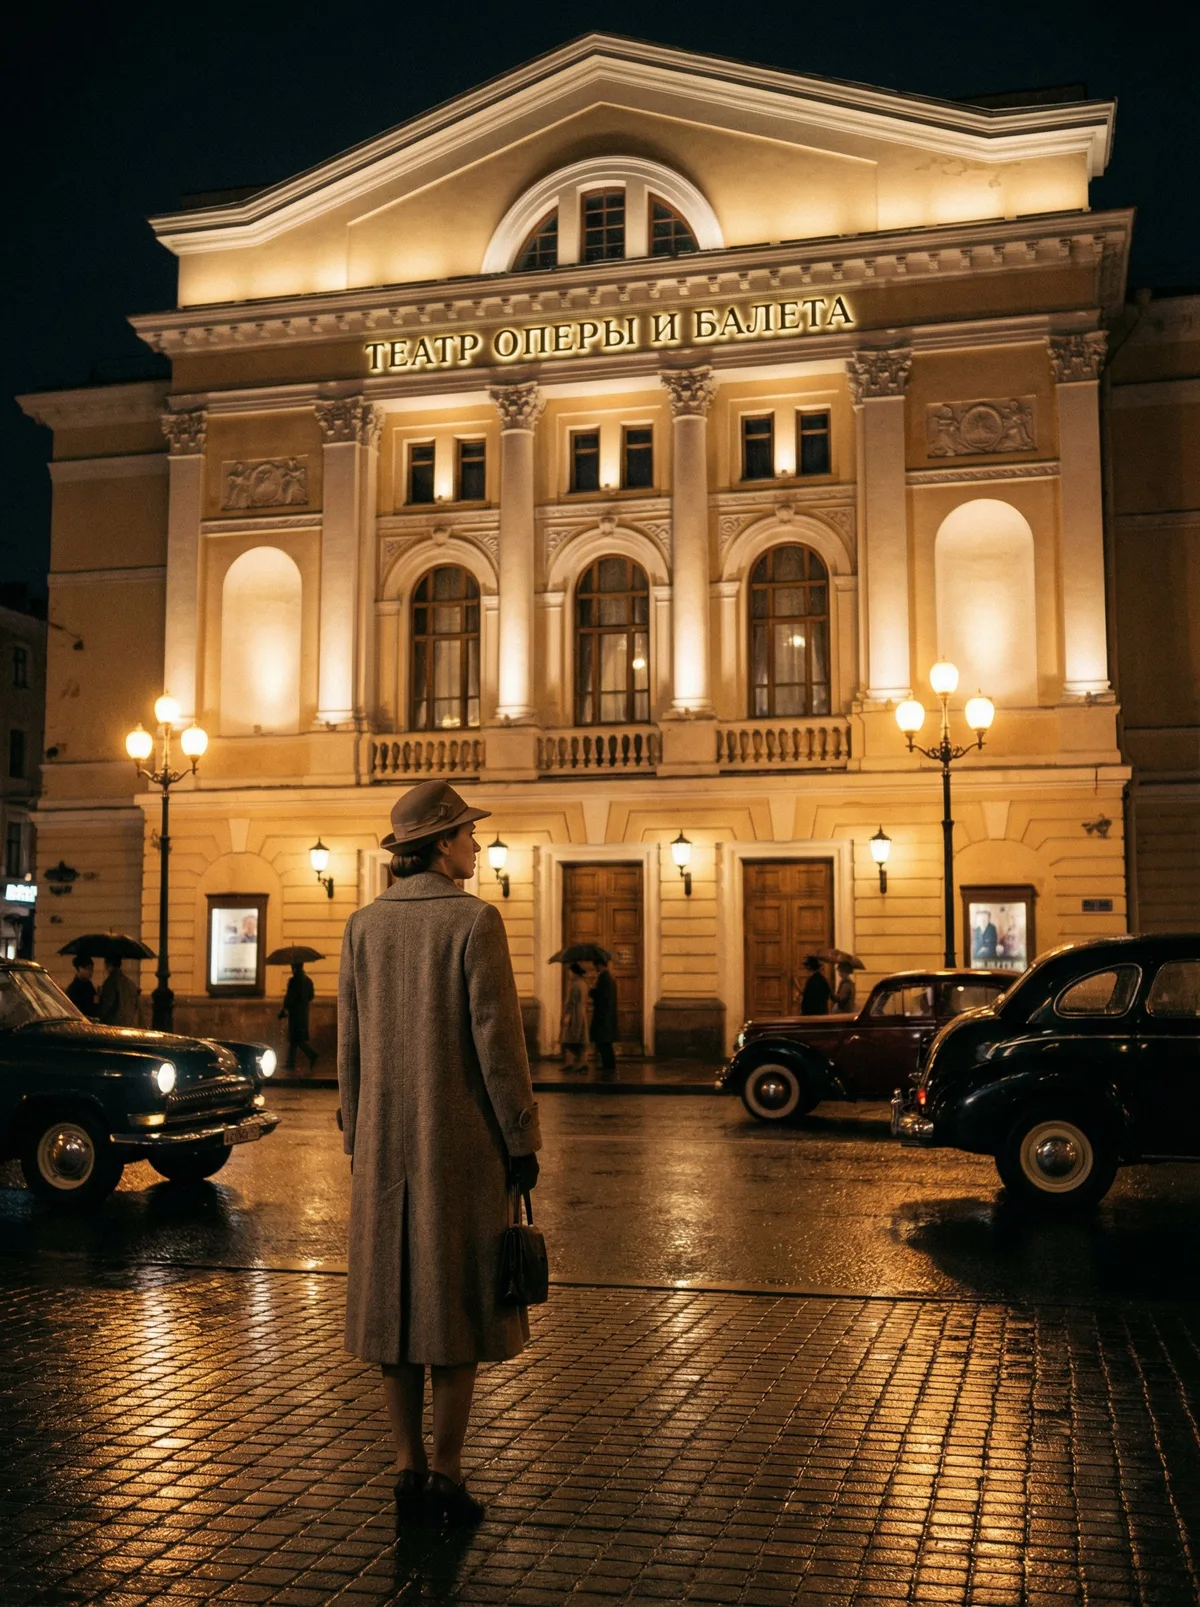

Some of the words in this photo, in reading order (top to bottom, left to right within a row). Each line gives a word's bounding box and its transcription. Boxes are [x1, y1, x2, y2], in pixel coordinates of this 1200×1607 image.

[364, 333, 480, 370] ТЕАТР
[493, 317, 637, 357] ОПЕРЫ
[651, 313, 679, 343] И
[693, 296, 854, 339] БАЛЕТА
